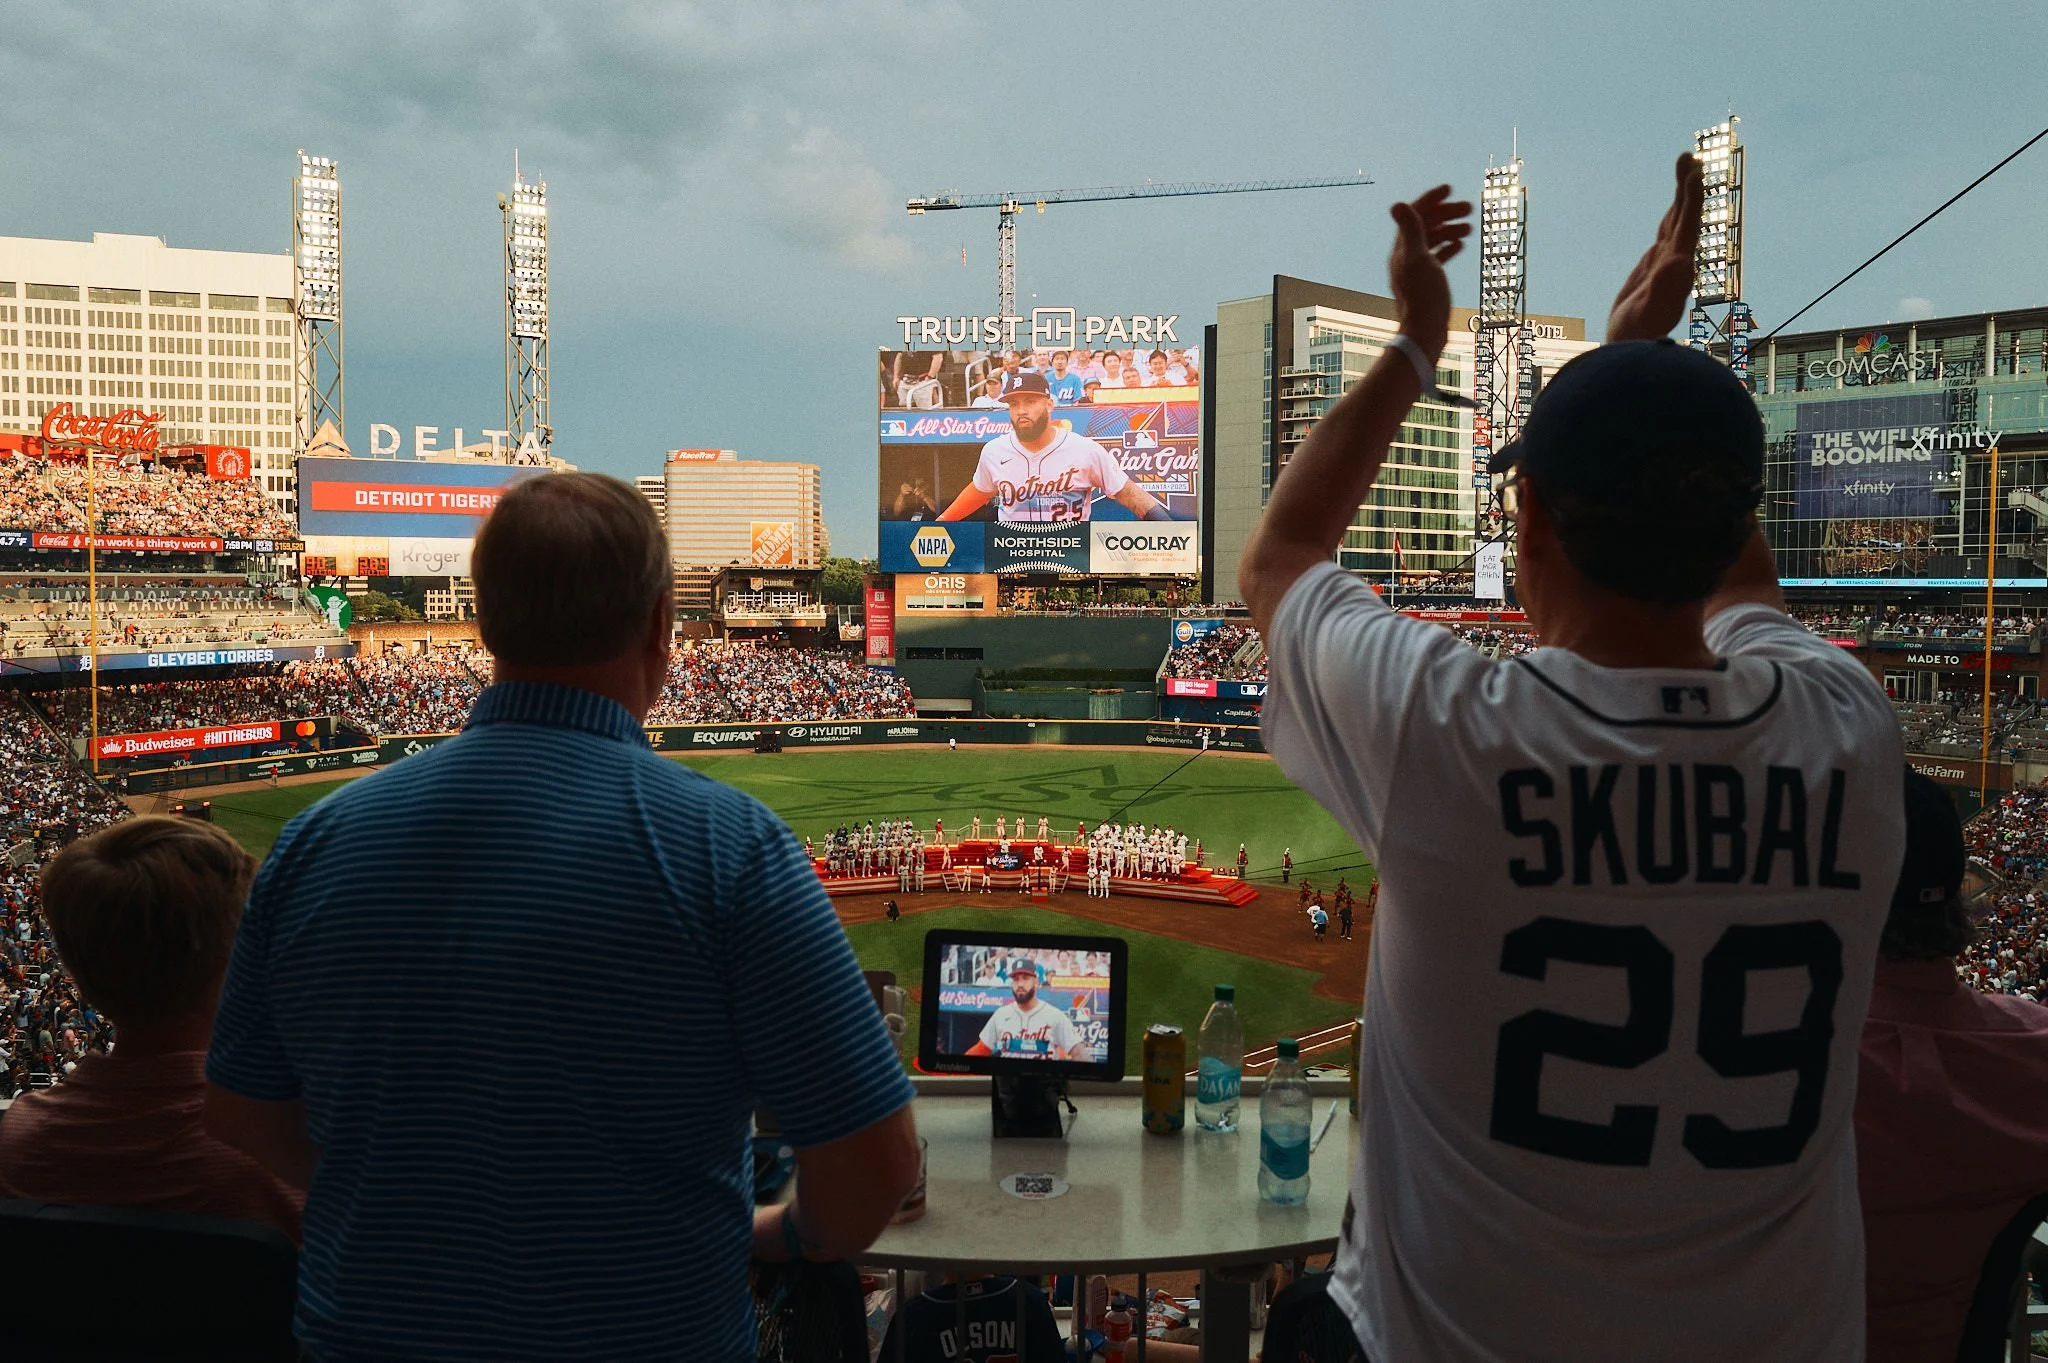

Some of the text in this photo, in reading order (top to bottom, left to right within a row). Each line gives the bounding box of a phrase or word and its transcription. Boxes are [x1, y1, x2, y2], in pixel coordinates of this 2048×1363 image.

[897, 314, 1179, 344] TRUIST PARK
[1808, 349, 1942, 379] COMCAST
[42, 402, 165, 451] Coca-Cola
[370, 423, 545, 461] DELTA
[1812, 432, 1853, 449] THE
[1858, 428, 1907, 446] WIFI
[1910, 426, 2004, 456] xfinity
[678, 451, 716, 461] RaceTrac
[1811, 445, 1932, 467] BOOMING
[998, 467, 1079, 507] Detroit
[1843, 479, 1896, 497] xfinity
[355, 489, 435, 507] DETRIOT
[40, 535, 70, 547] Coca-Cola
[106, 538, 134, 548] work
[136, 538, 145, 548] is
[147, 539, 180, 550] thirsty
[182, 540, 208, 549] work
[752, 522, 793, 564] HOME
[755, 527, 772, 543] THE
[993, 537, 1082, 548] NORTHSIDE
[1105, 535, 1191, 551] COOLRAY
[918, 538, 949, 555] NAPA
[1009, 549, 1066, 558] HOSPITAL
[402, 545, 461, 573] Kroger
[924, 576, 966, 589] ORIS
[1177, 628, 1191, 636] Gulf
[147, 649, 274, 668] GLEYBER TORRES
[1907, 654, 1941, 664] MADE
[1944, 655, 1960, 665] TO
[203, 726, 273, 745] #HITTHEBUDS
[692, 731, 755, 745] EQUIFAX
[809, 726, 862, 737] HYUNDAI
[125, 736, 194, 753] Budweiser
[1498, 763, 1862, 891] SKUBAL
[1489, 916, 1844, 1170] 29
[939, 1320, 1017, 1358] OSON
